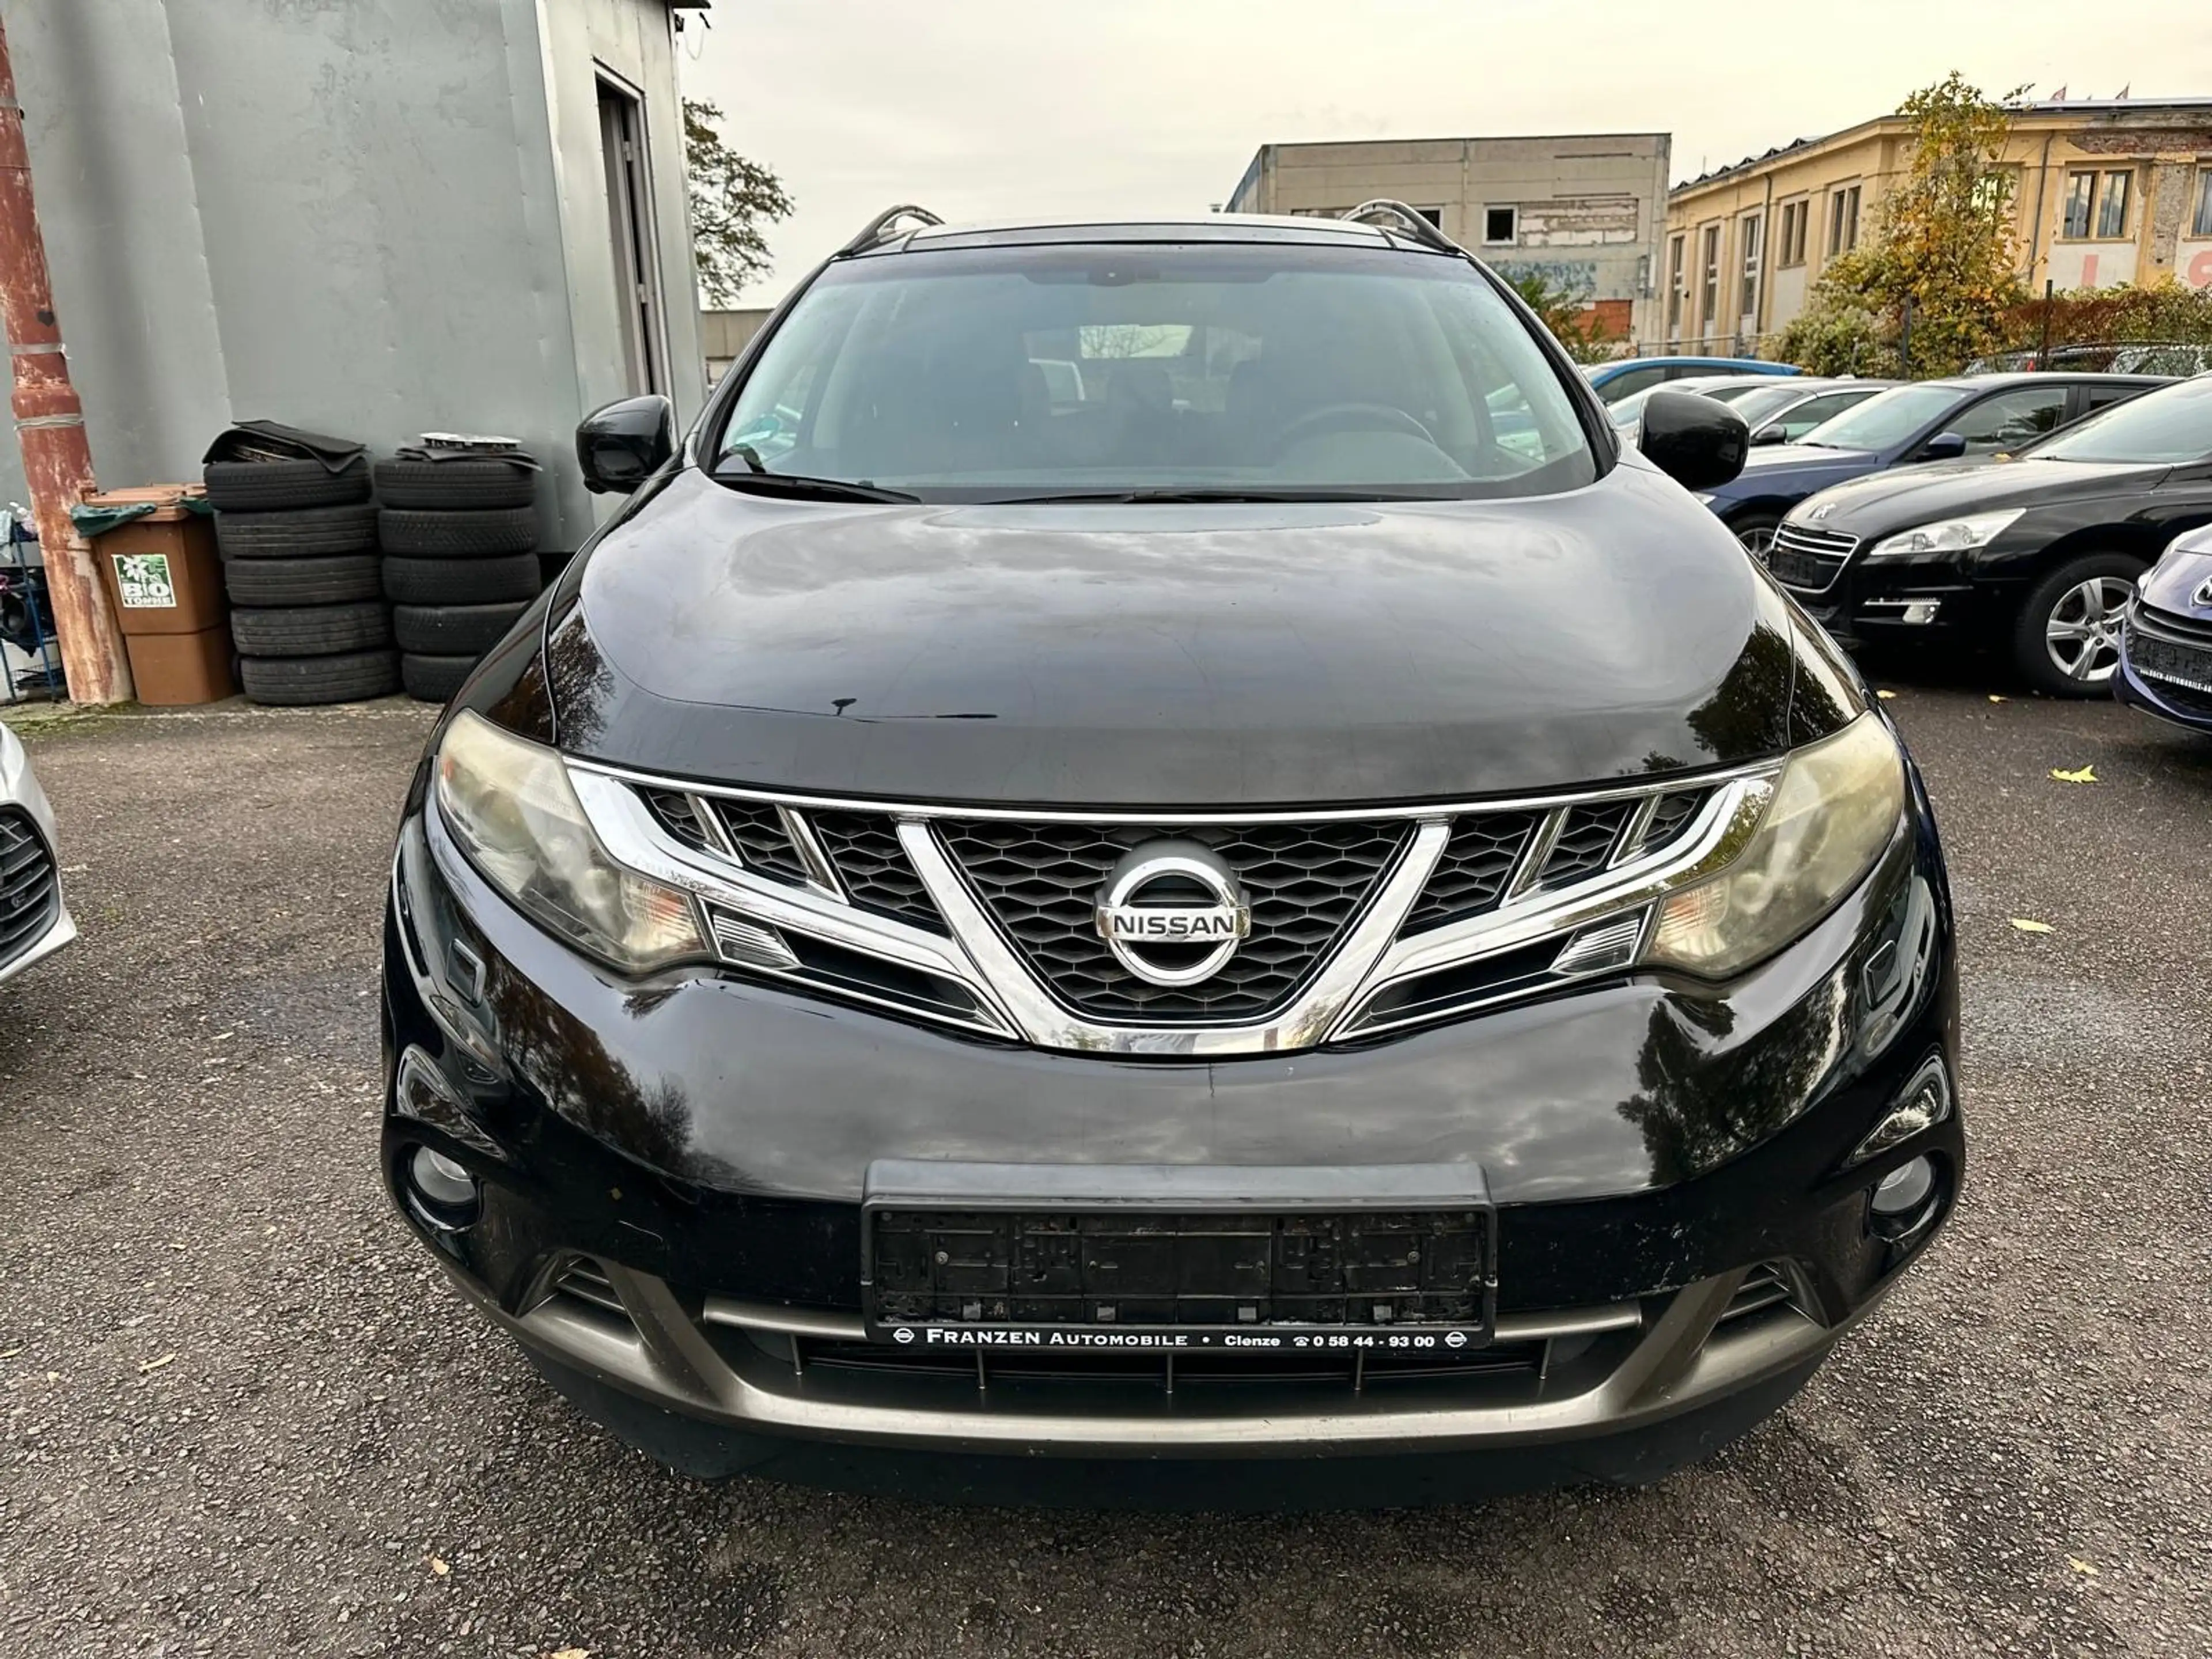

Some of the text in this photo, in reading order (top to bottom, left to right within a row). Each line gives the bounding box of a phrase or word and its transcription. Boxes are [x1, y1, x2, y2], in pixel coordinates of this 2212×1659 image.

[122, 582, 170, 597] BIO
[1114, 915, 1234, 934] NISSAN
[927, 1329, 1040, 1344] FRANZEN
[1050, 1332, 1187, 1346] AUTOMOBILE
[1225, 1335, 1281, 1346] Clenze
[1328, 1335, 1349, 1347] 58
[1353, 1336, 1374, 1347] 44
[1389, 1336, 1410, 1347] 93
[1414, 1336, 1435, 1347] 00
